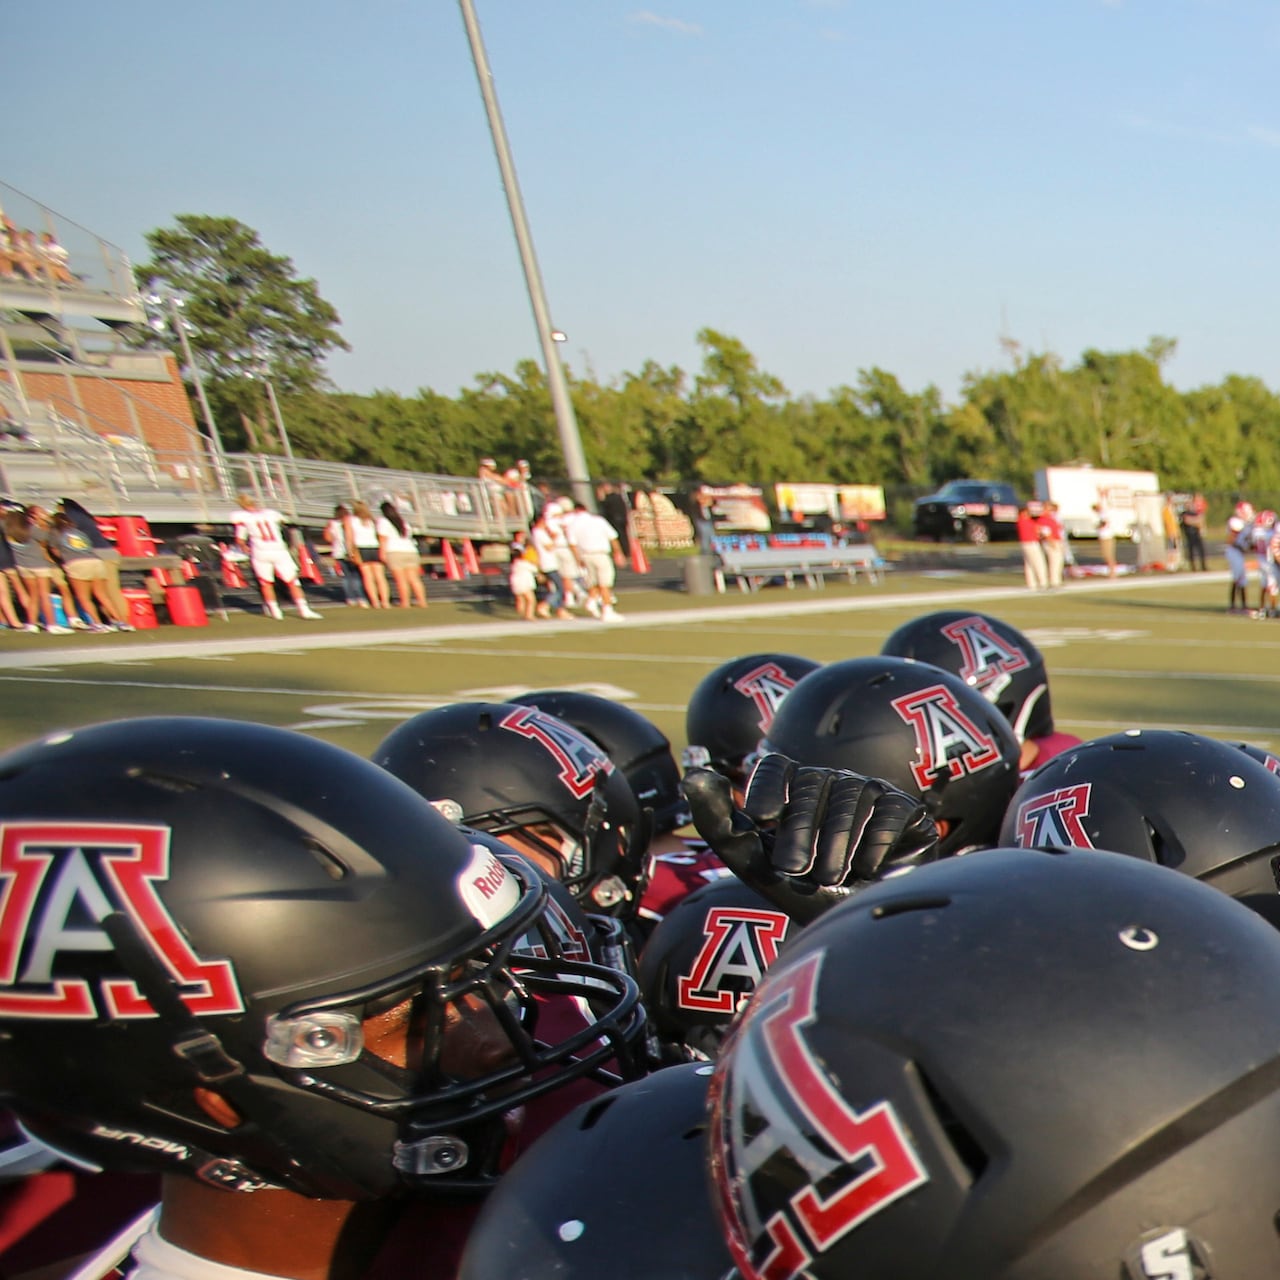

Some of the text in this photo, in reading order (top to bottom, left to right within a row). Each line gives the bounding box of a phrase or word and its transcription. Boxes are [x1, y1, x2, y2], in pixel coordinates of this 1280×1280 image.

[939, 614, 1031, 688] A
[500, 704, 617, 800] A
[892, 683, 1003, 792] A
[0, 821, 245, 1020] A
[472, 853, 508, 900] Ridd
[677, 906, 790, 1014] A
